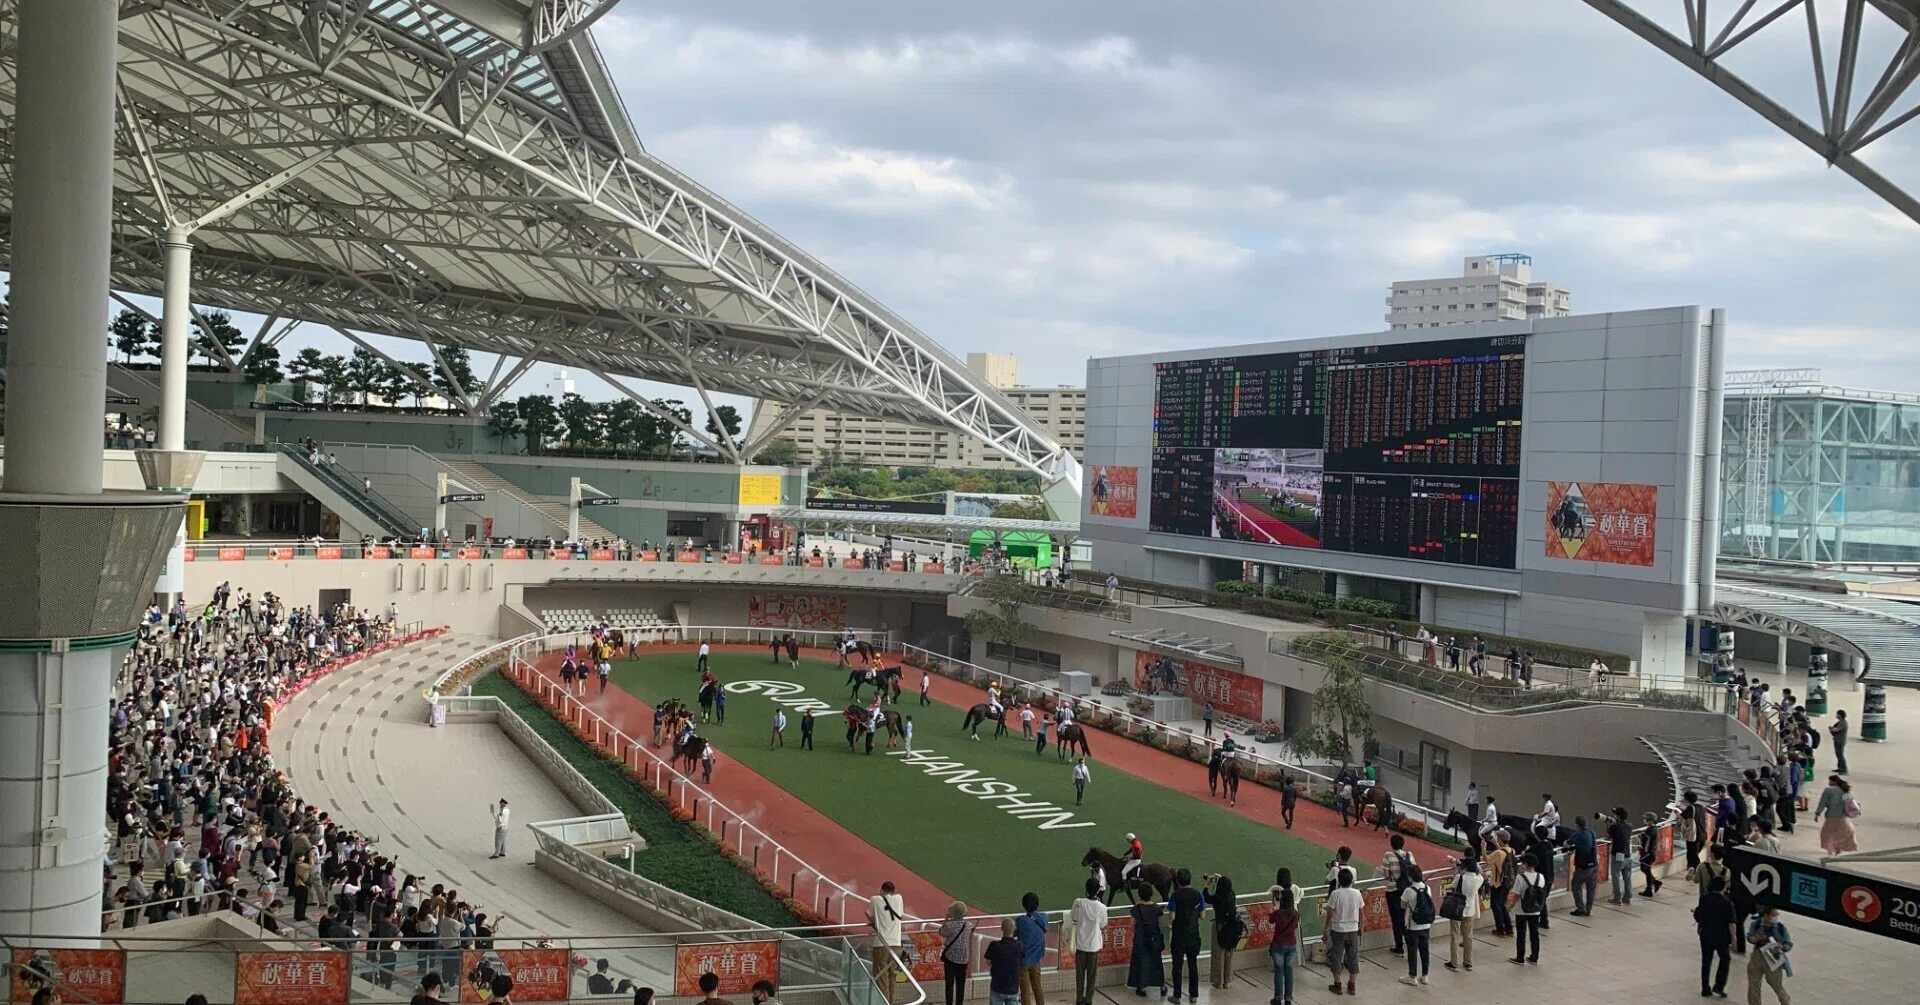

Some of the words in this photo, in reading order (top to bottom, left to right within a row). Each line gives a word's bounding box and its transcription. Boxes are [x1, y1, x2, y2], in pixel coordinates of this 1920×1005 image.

[642, 475, 661, 496] 2F
[1600, 513, 1648, 536] 秋華賞
[1194, 673, 1231, 703] 秋華賞
[885, 749, 1097, 830] HANSHIN
[1799, 878, 1820, 898] 西
[1891, 897, 1920, 919] 20
[261, 963, 326, 985] 秋華賞
[698, 952, 757, 975] 秋華賞
[68, 969, 113, 985] 秋華賞
[516, 968, 558, 983] 秋華賞
